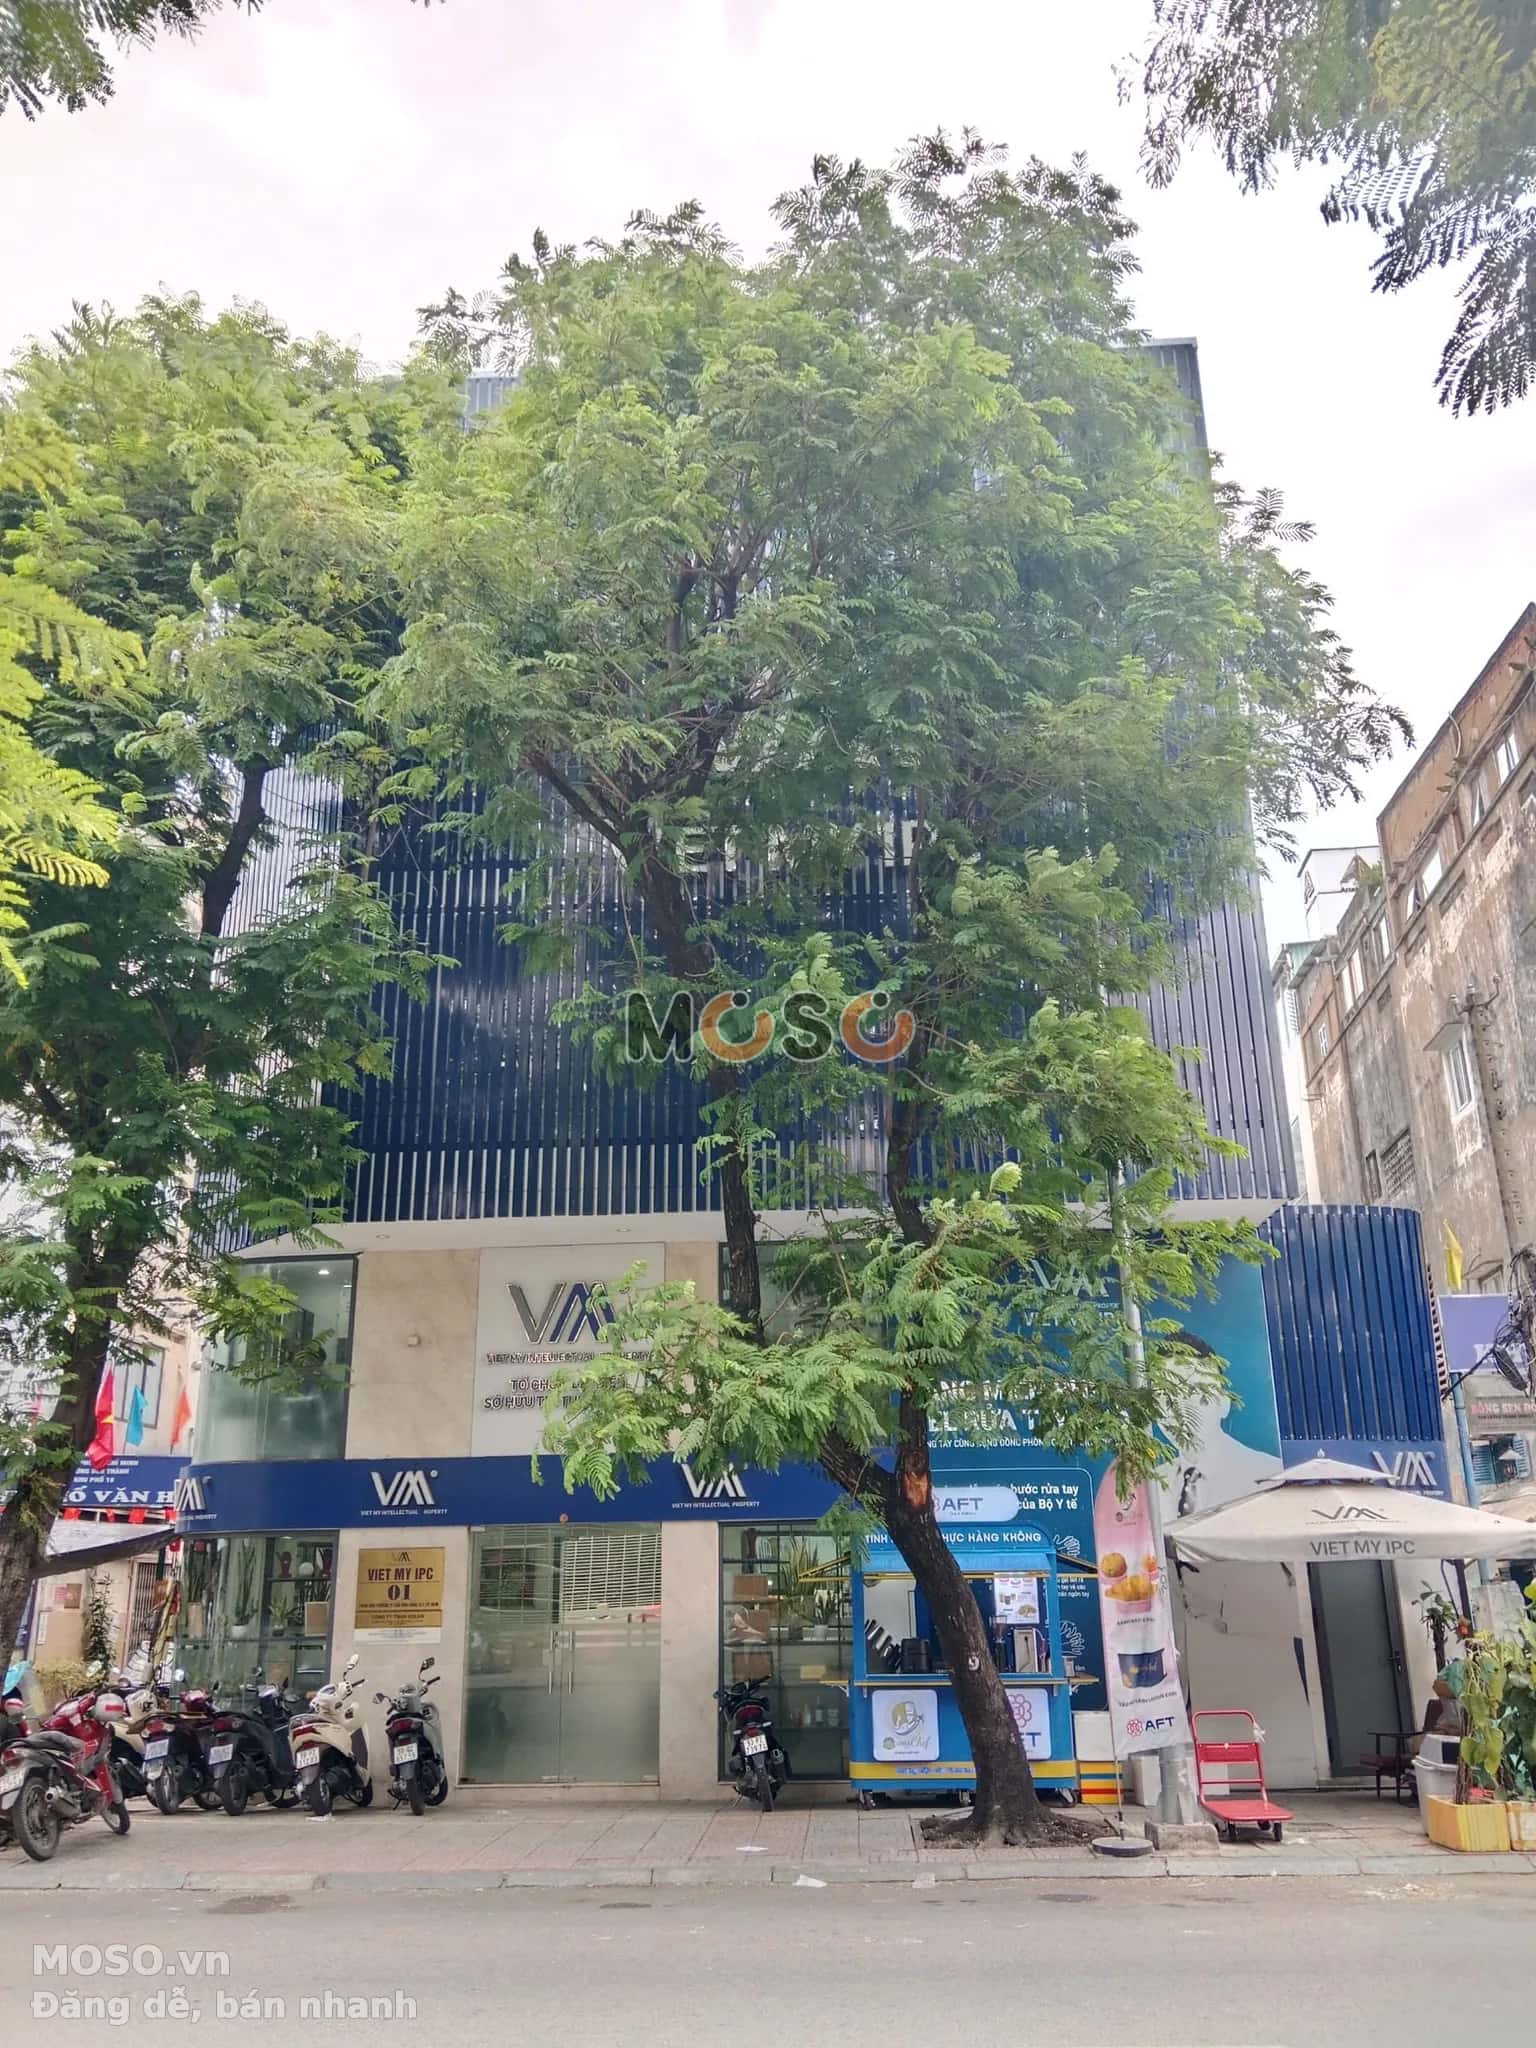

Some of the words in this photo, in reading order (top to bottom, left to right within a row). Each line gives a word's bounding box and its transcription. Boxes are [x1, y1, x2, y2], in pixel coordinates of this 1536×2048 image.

[94, 1487, 150, 1503] VĂN
[1062, 1484, 1079, 1497] tay
[942, 1498, 984, 1511] AFT
[1039, 1498, 1054, 1511] Bộ
[1055, 1500, 1065, 1510] Y
[941, 1532, 965, 1545] HỰC
[967, 1530, 1000, 1543] HÀNG
[1002, 1531, 1042, 1543] KHÔNG
[1310, 1541, 1350, 1556] VIET
[1354, 1540, 1383, 1555] MY
[1385, 1540, 1416, 1554] IPC
[367, 1568, 392, 1581] VIET
[394, 1568, 412, 1580] MY
[415, 1567, 434, 1580] IPC
[1145, 1716, 1175, 1732] AFT
